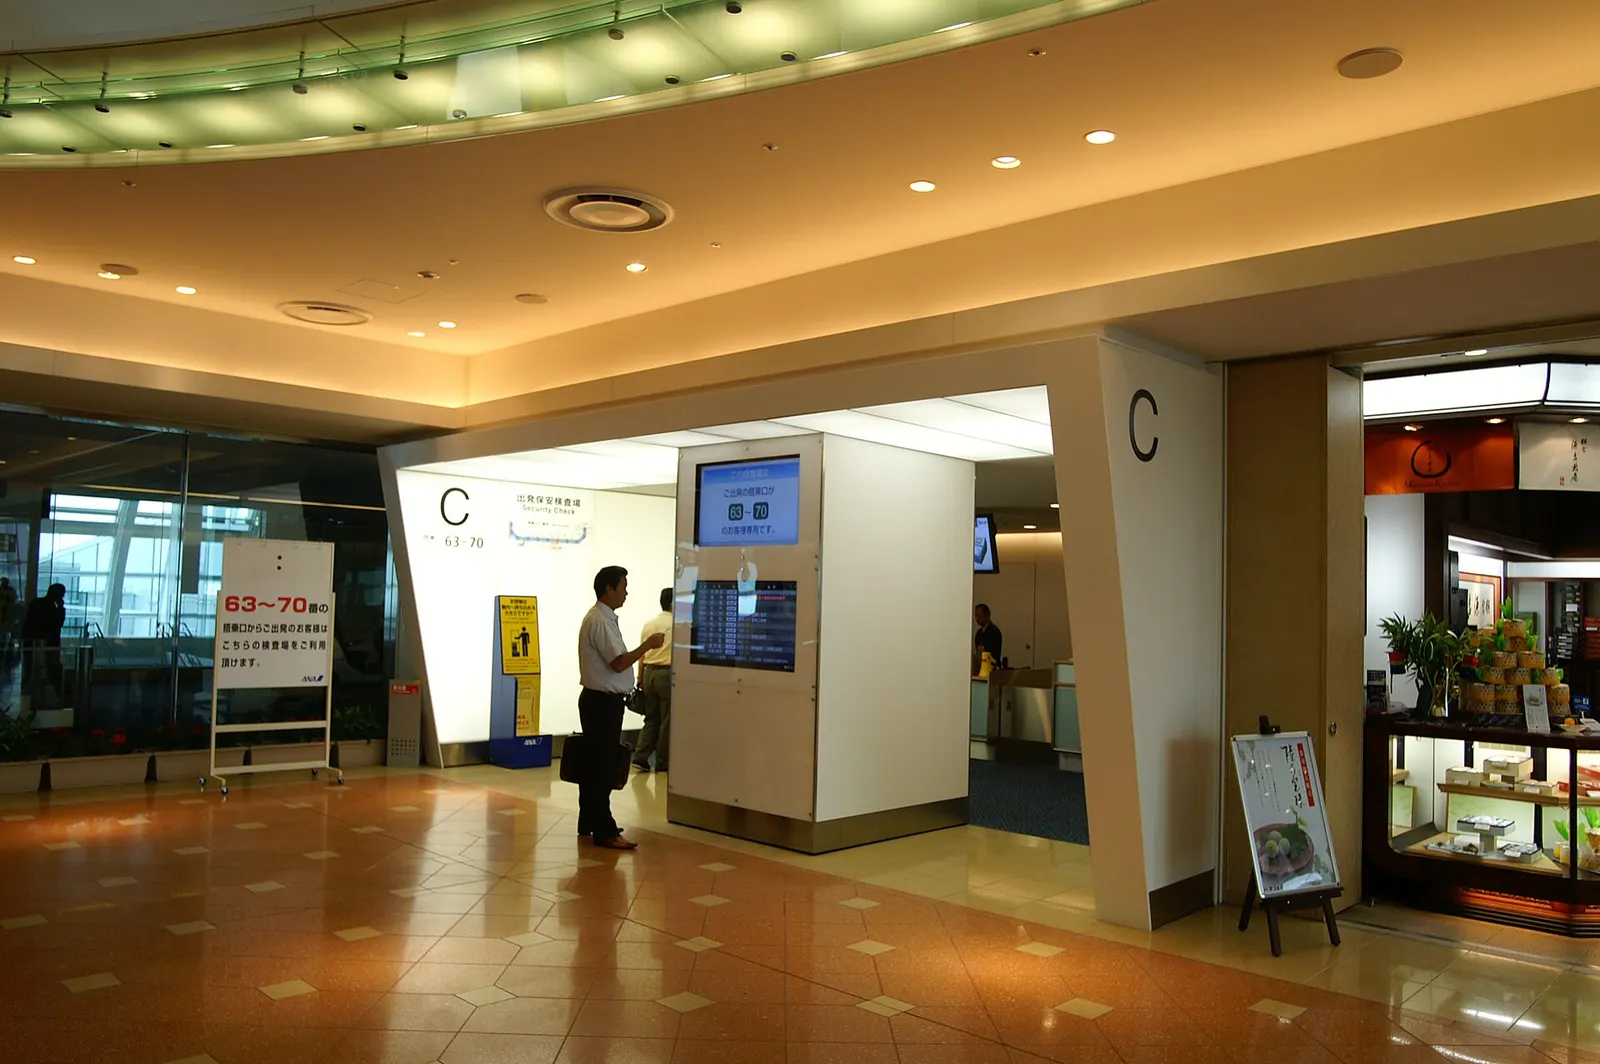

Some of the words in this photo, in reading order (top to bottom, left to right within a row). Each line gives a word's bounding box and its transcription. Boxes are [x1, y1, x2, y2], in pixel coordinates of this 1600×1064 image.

[1128, 388, 1159, 462] C
[440, 487, 470, 526] C
[516, 494, 581, 508] 出発保安検査場
[522, 504, 552, 514] Security
[553, 506, 576, 515] Check
[222, 622, 328, 634] 搭乗口からご出発のお客様は
[222, 640, 326, 651] こちらの検査場をご利用
[221, 657, 260, 669] 頂けます。
[301, 675, 318, 683] ANA
